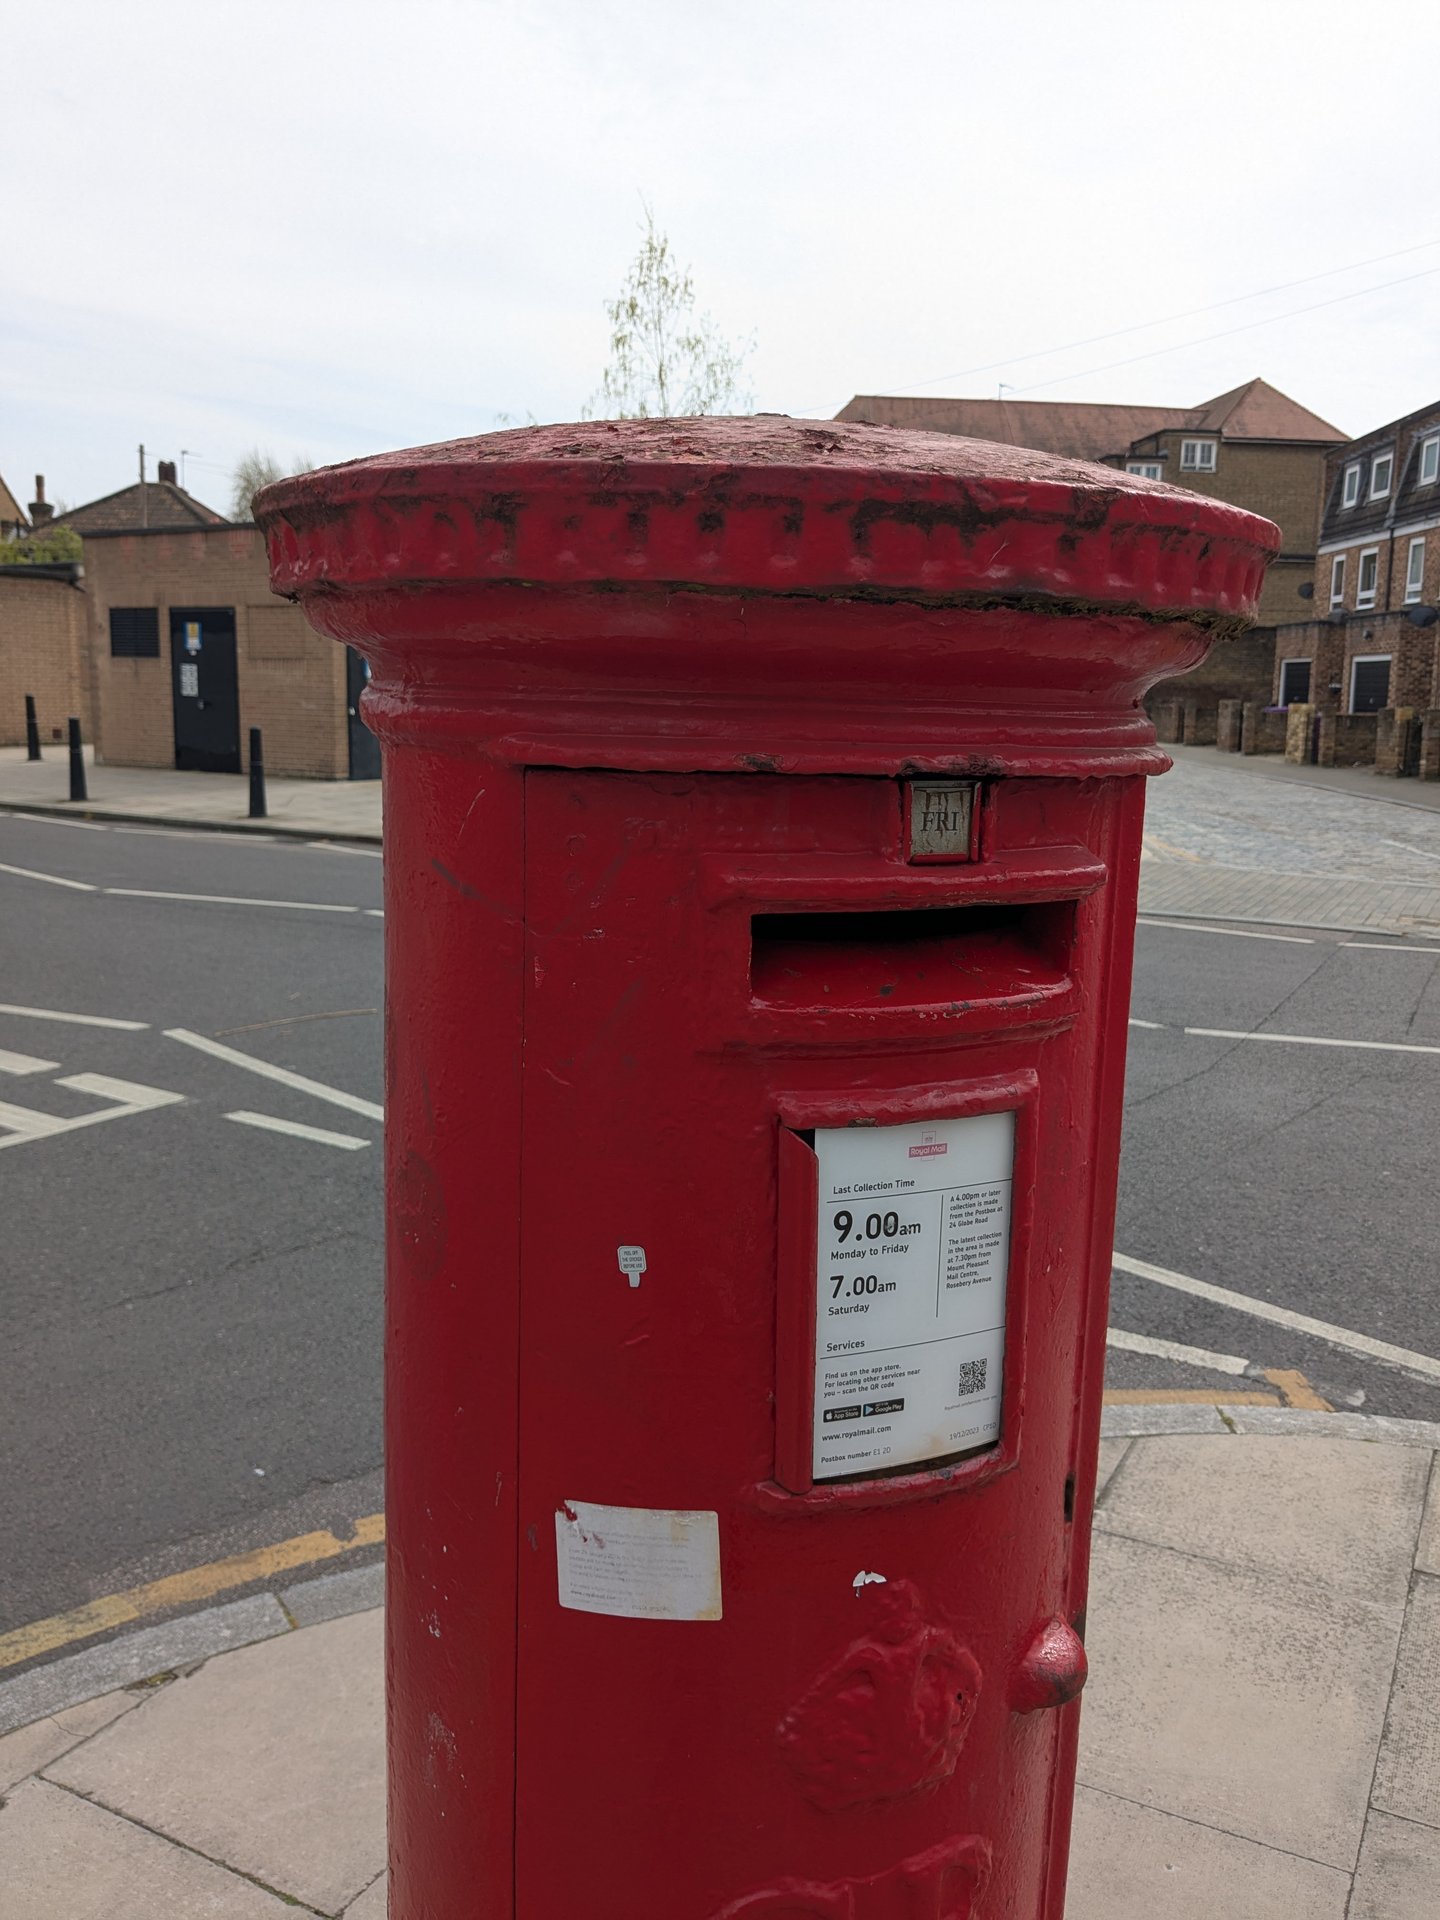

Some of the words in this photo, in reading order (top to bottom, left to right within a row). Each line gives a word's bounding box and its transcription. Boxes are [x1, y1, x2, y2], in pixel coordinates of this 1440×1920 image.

[920, 811, 960, 832] FRI
[910, 1146, 930, 1156] Royal
[931, 1144, 946, 1153] Mail
[833, 1185, 851, 1195] Last
[854, 1182, 892, 1193] Collection
[895, 1179, 915, 1188] Time
[956, 1192, 980, 1202] 4.00pm
[988, 1189, 1001, 1197] later
[950, 1201, 976, 1212] collection
[984, 1198, 999, 1206] made
[975, 1208, 996, 1216] Postbox
[833, 1210, 921, 1244] 9.00am
[949, 1221, 957, 1229] 24
[958, 1219, 974, 1227] Globe
[960, 1236, 976, 1244] latest
[977, 1231, 1002, 1241] collection
[985, 1240, 1000, 1248] made
[831, 1249, 867, 1261] Monday
[869, 1247, 879, 1256] to
[882, 1244, 910, 1254] Friday
[955, 1253, 978, 1263] 7.30pm
[947, 1264, 965, 1272] Mount
[966, 1259, 989, 1269] Pleasant
[946, 1281, 972, 1289] Rosebery
[972, 1276, 992, 1284] Avenue
[947, 1273, 959, 1281] Mail
[830, 1275, 896, 1299] 7.00am
[828, 1303, 870, 1316] Saturday
[826, 1340, 865, 1352] Services
[825, 1372, 839, 1380] Find
[860, 1367, 869, 1375] the
[884, 1364, 901, 1372] store.
[824, 1381, 835, 1389] For
[837, 1378, 862, 1387] locating
[863, 1375, 879, 1383] other
[881, 1371, 906, 1381] services
[858, 1384, 869, 1392] the
[870, 1383, 879, 1391] QR
[880, 1381, 895, 1389] code
[874, 1405, 892, 1413] Google
[822, 1425, 892, 1442] www.royalmail.com
[821, 1455, 846, 1463] Postbox
[847, 1450, 871, 1460] number
